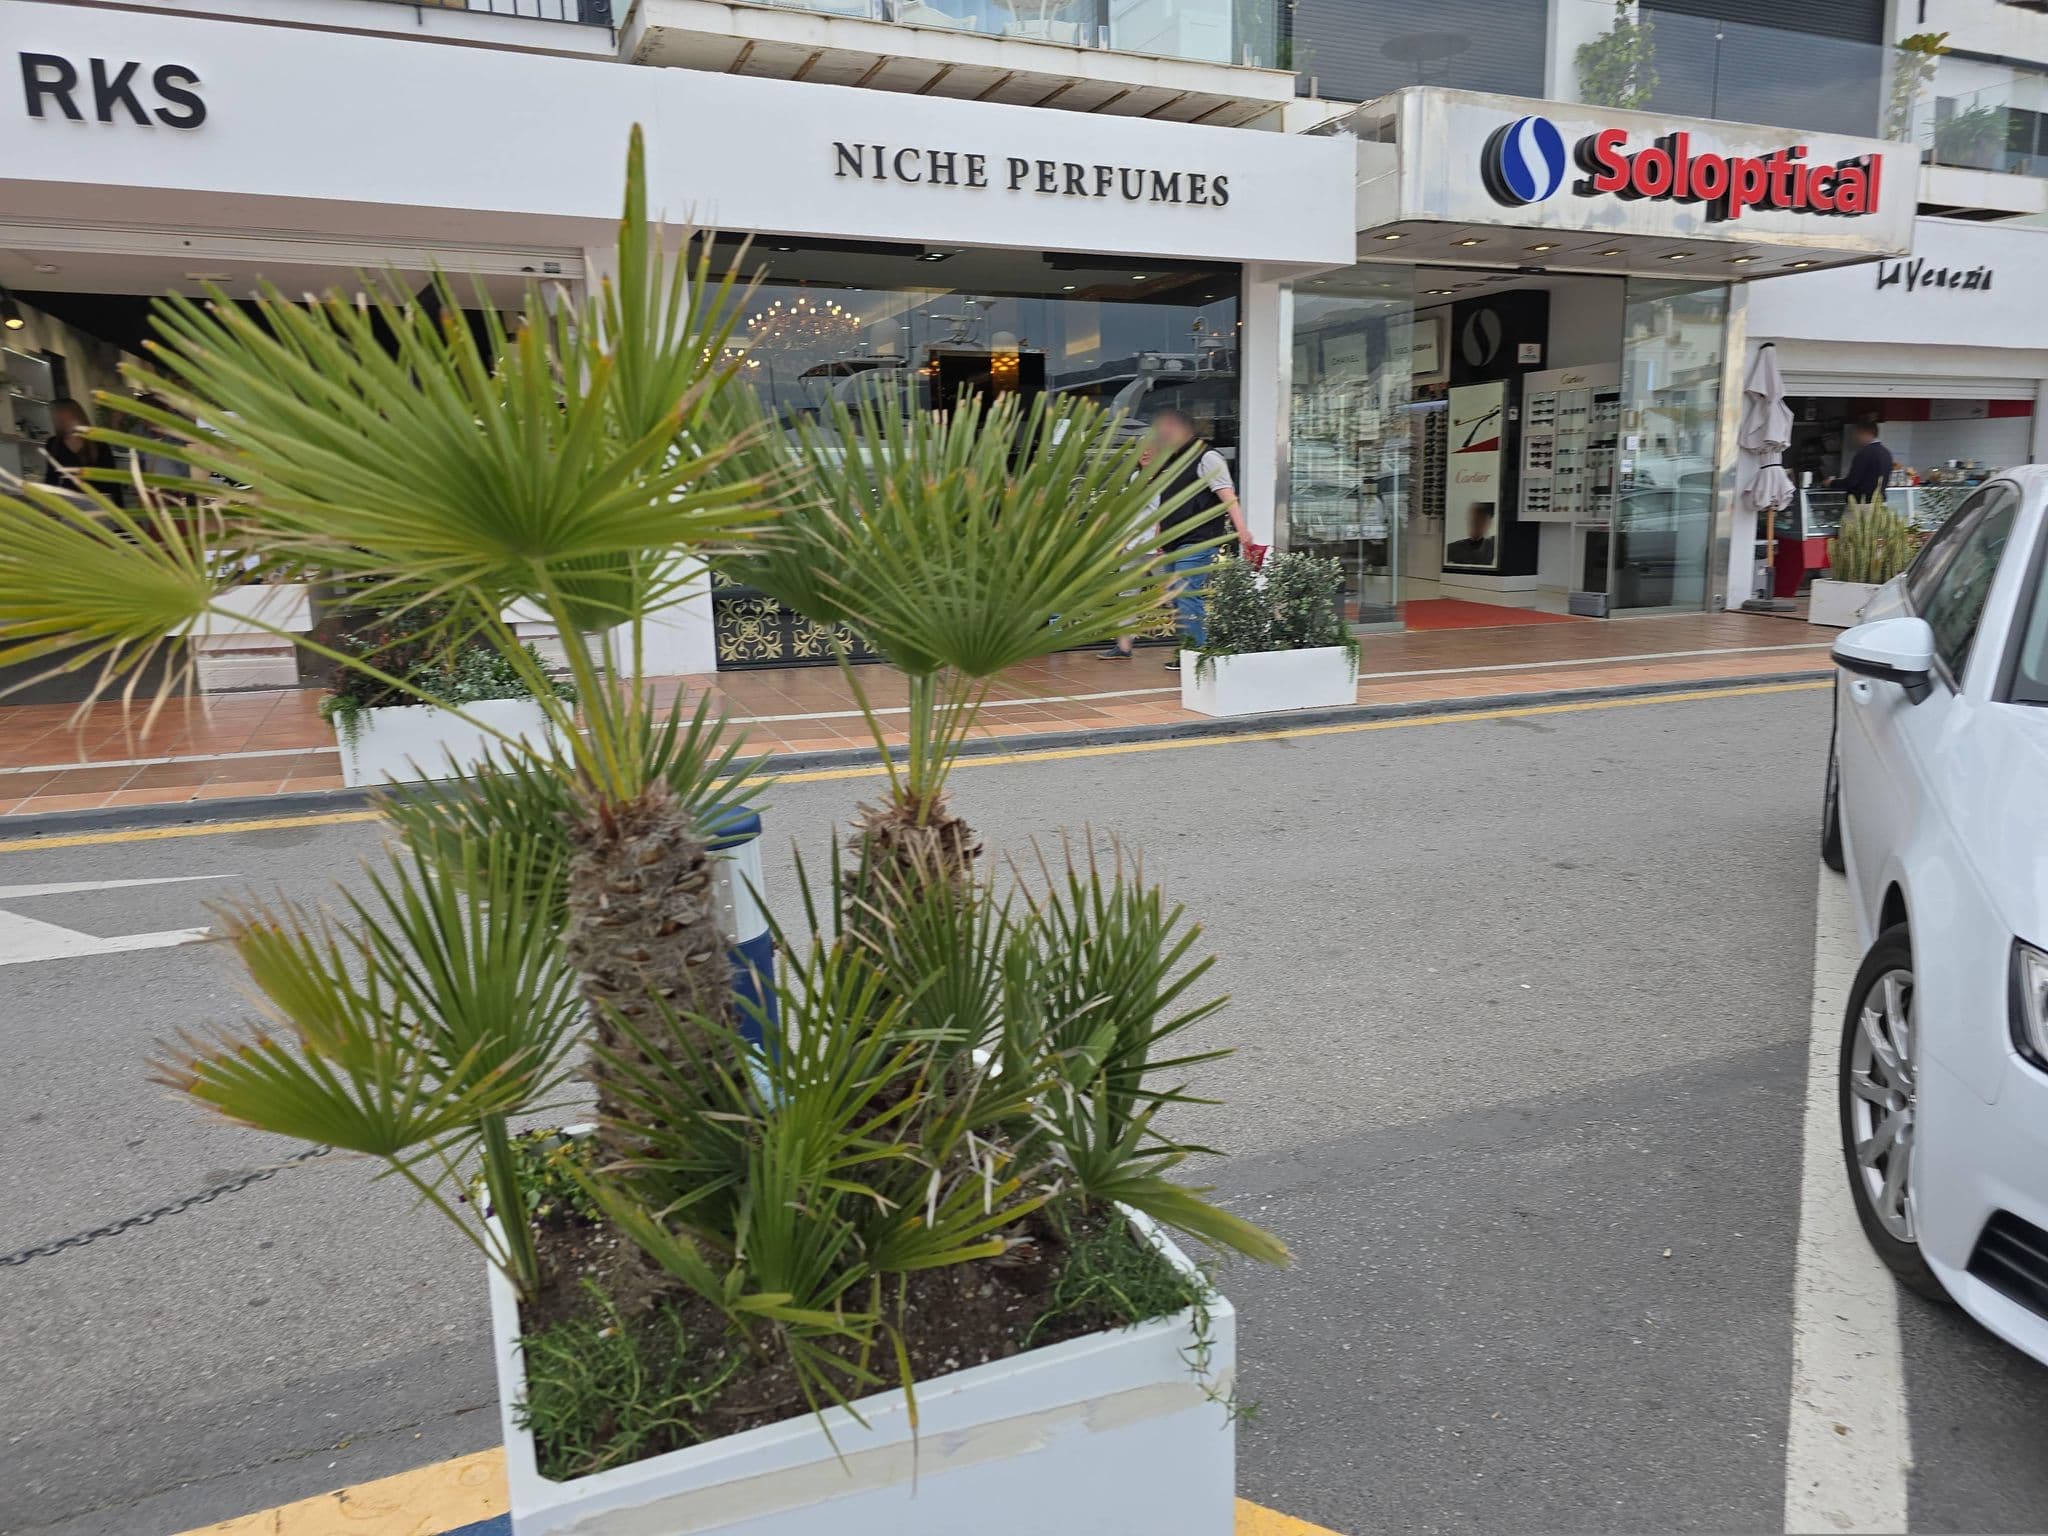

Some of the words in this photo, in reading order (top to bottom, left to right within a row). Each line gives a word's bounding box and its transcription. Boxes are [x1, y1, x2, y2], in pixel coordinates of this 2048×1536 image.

[18, 51, 207, 129] RKS
[832, 141, 989, 188] NICHE
[1006, 156, 1230, 207] PERFUMES
[1590, 128, 1883, 220] Soloptical
[1906, 257, 1993, 292] Venezia
[1455, 468, 1492, 484] Cartier
